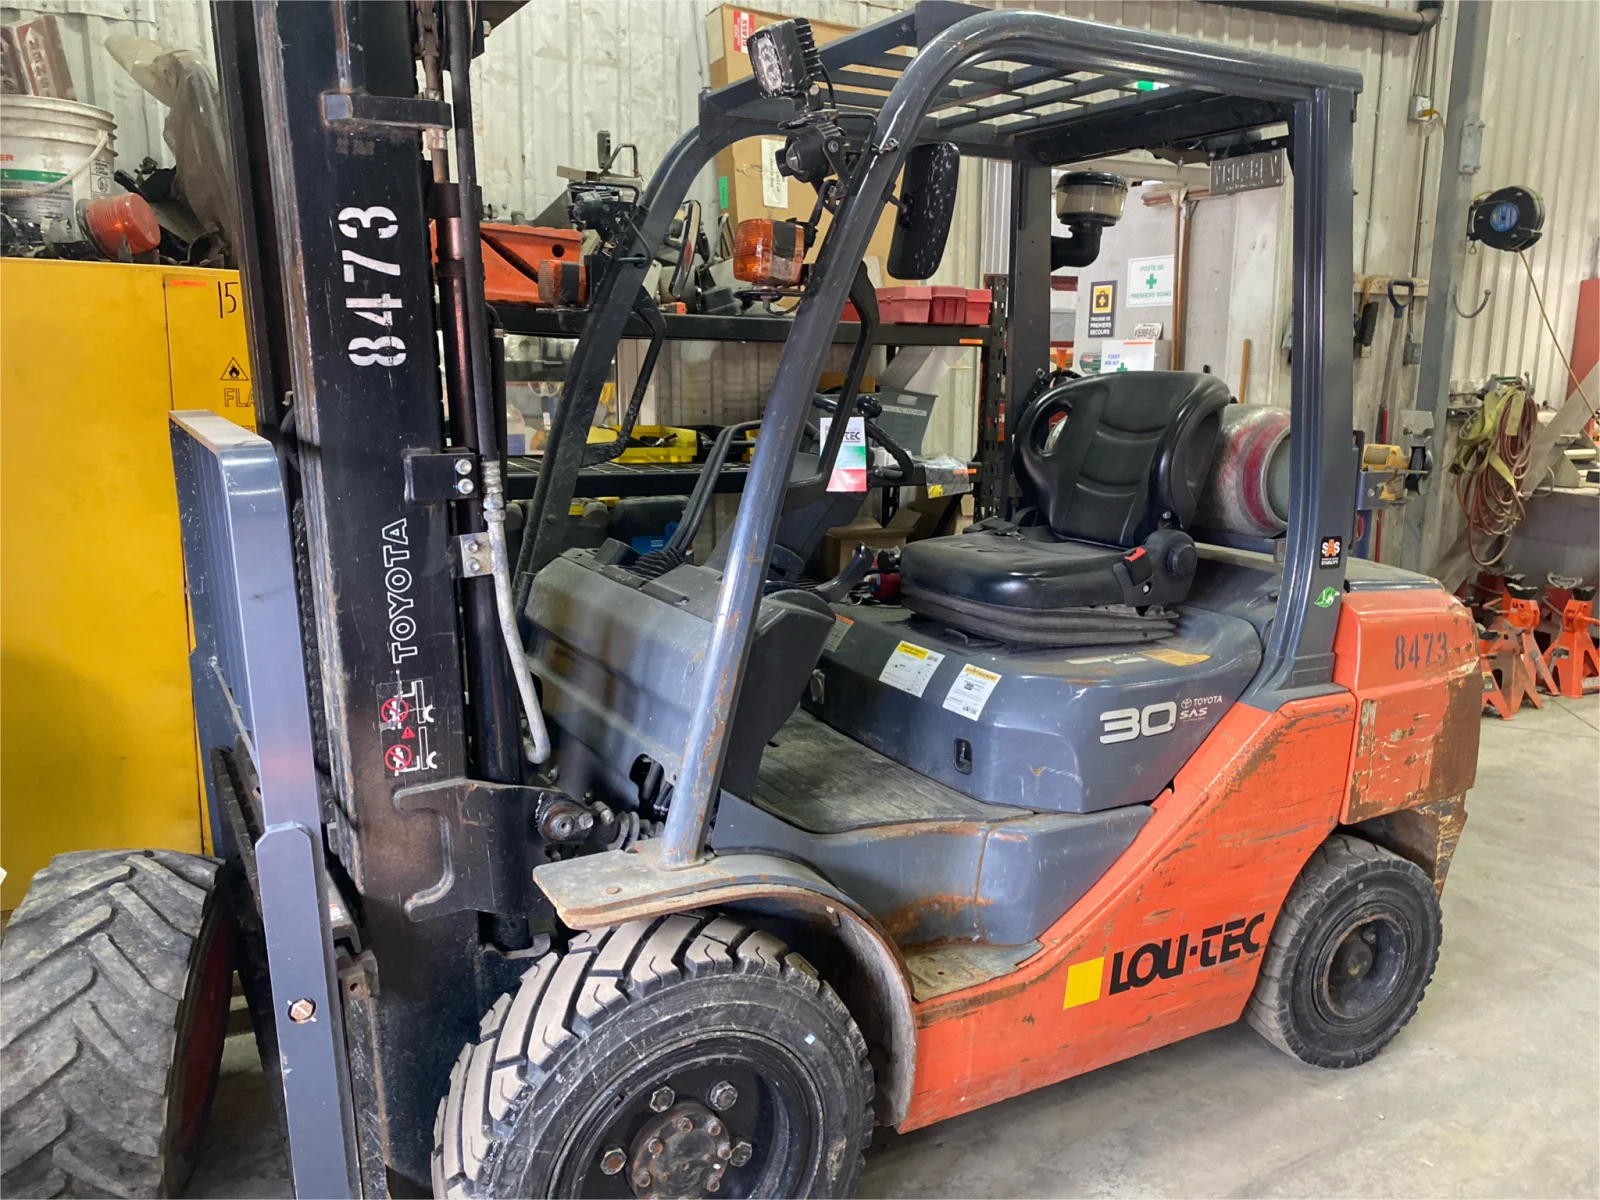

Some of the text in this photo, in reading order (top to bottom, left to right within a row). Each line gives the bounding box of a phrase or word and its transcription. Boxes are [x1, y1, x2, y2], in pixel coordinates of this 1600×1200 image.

[217, 281, 239, 319] 15
[338, 206, 407, 367] 8473
[844, 431, 861, 441] TEC
[1321, 538, 1341, 557] SAS
[382, 518, 418, 664] TOYOTA
[1394, 631, 1449, 671] 8473
[1179, 707, 1208, 720] SAS
[1193, 695, 1223, 707] TOYOTA
[1099, 700, 1178, 745] 30
[1109, 912, 1266, 996] LOU-TEC
